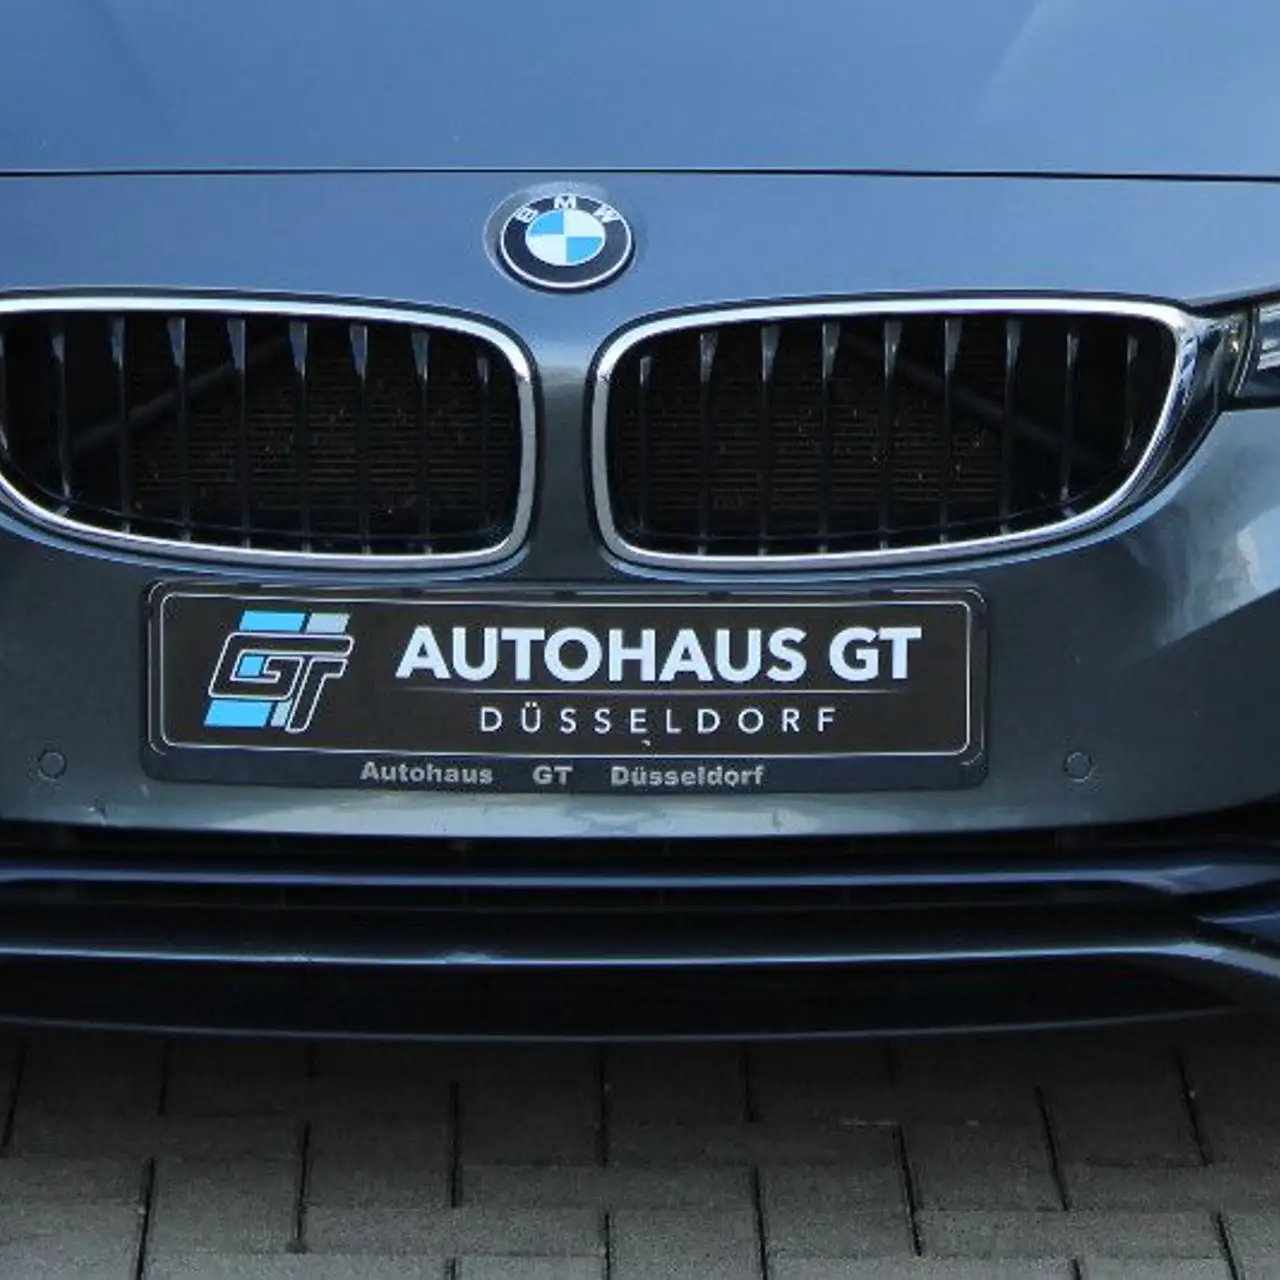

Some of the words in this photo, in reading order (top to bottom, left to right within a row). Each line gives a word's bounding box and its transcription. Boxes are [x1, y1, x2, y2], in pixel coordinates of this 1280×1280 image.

[515, 193, 621, 223] BMW
[394, 625, 807, 682] AUTOHAUS
[828, 626, 922, 682] GT
[208, 631, 355, 734] GT
[480, 702, 836, 734] DÜSSELDORF
[360, 761, 493, 784] Autohaus
[532, 765, 574, 785] GT
[610, 764, 766, 788] Düsseldorf
